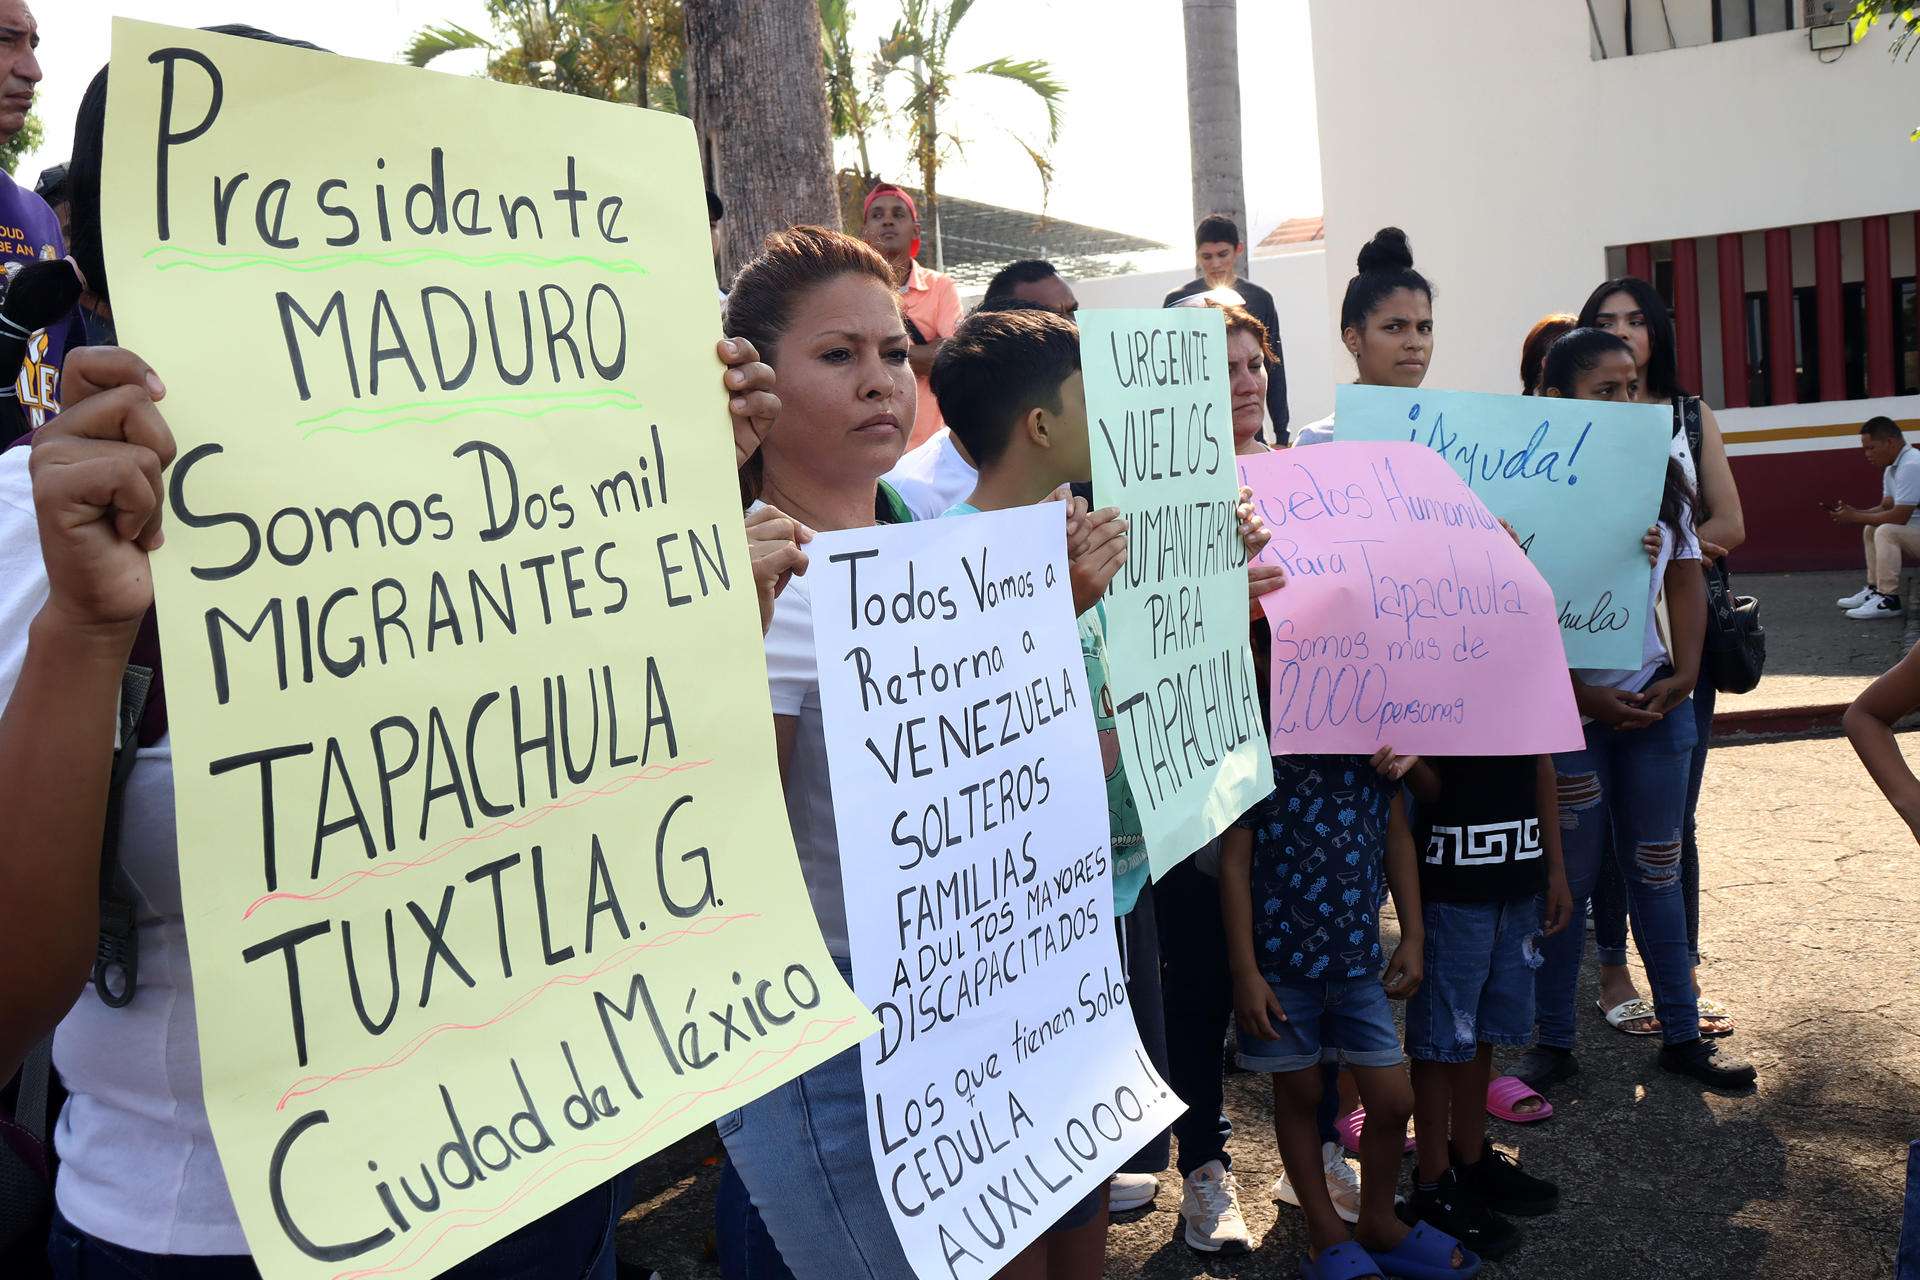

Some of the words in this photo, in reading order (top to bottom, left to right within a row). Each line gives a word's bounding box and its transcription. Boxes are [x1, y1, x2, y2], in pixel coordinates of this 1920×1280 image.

[148, 47, 629, 248] Presidente
[16, 243, 35, 257] AN
[276, 283, 627, 401] MADURO
[1110, 329, 1210, 388] URGENTE
[1098, 403, 1220, 487] VUELOS
[1241, 463, 1374, 528] uelos
[169, 443, 454, 581] Somos
[453, 440, 575, 542] Dos
[590, 425, 669, 517] mil
[829, 548, 958, 630] Todos
[961, 547, 1034, 613] Vamos
[1045, 563, 1056, 585] a
[1260, 538, 1347, 577] Para
[1332, 538, 1529, 640] Tapachula
[205, 542, 629, 704] MIGRANTES
[659, 523, 731, 608] EN
[1144, 586, 1205, 659] PARA
[1275, 620, 1370, 663] Somos
[1453, 626, 1490, 663] de
[843, 645, 1004, 712] Retorna
[1022, 630, 1036, 654] a
[209, 656, 679, 892] TAPACHULA
[865, 668, 1077, 784] VENEZUELA
[1116, 646, 1261, 811] TAPACHULA
[891, 757, 1050, 870] SOLTEROS
[896, 831, 1038, 951] FAMILIAS
[1026, 846, 1107, 921] MAYORES
[871, 898, 1099, 1066] DISCAPACITADOS
[954, 1052, 1002, 1108] que
[1012, 1005, 1076, 1064] tienen
[270, 1058, 555, 1262] Ciudad
[561, 1040, 621, 1131] de
[593, 963, 822, 1099] México
[891, 1090, 1034, 1218] CEDULA
